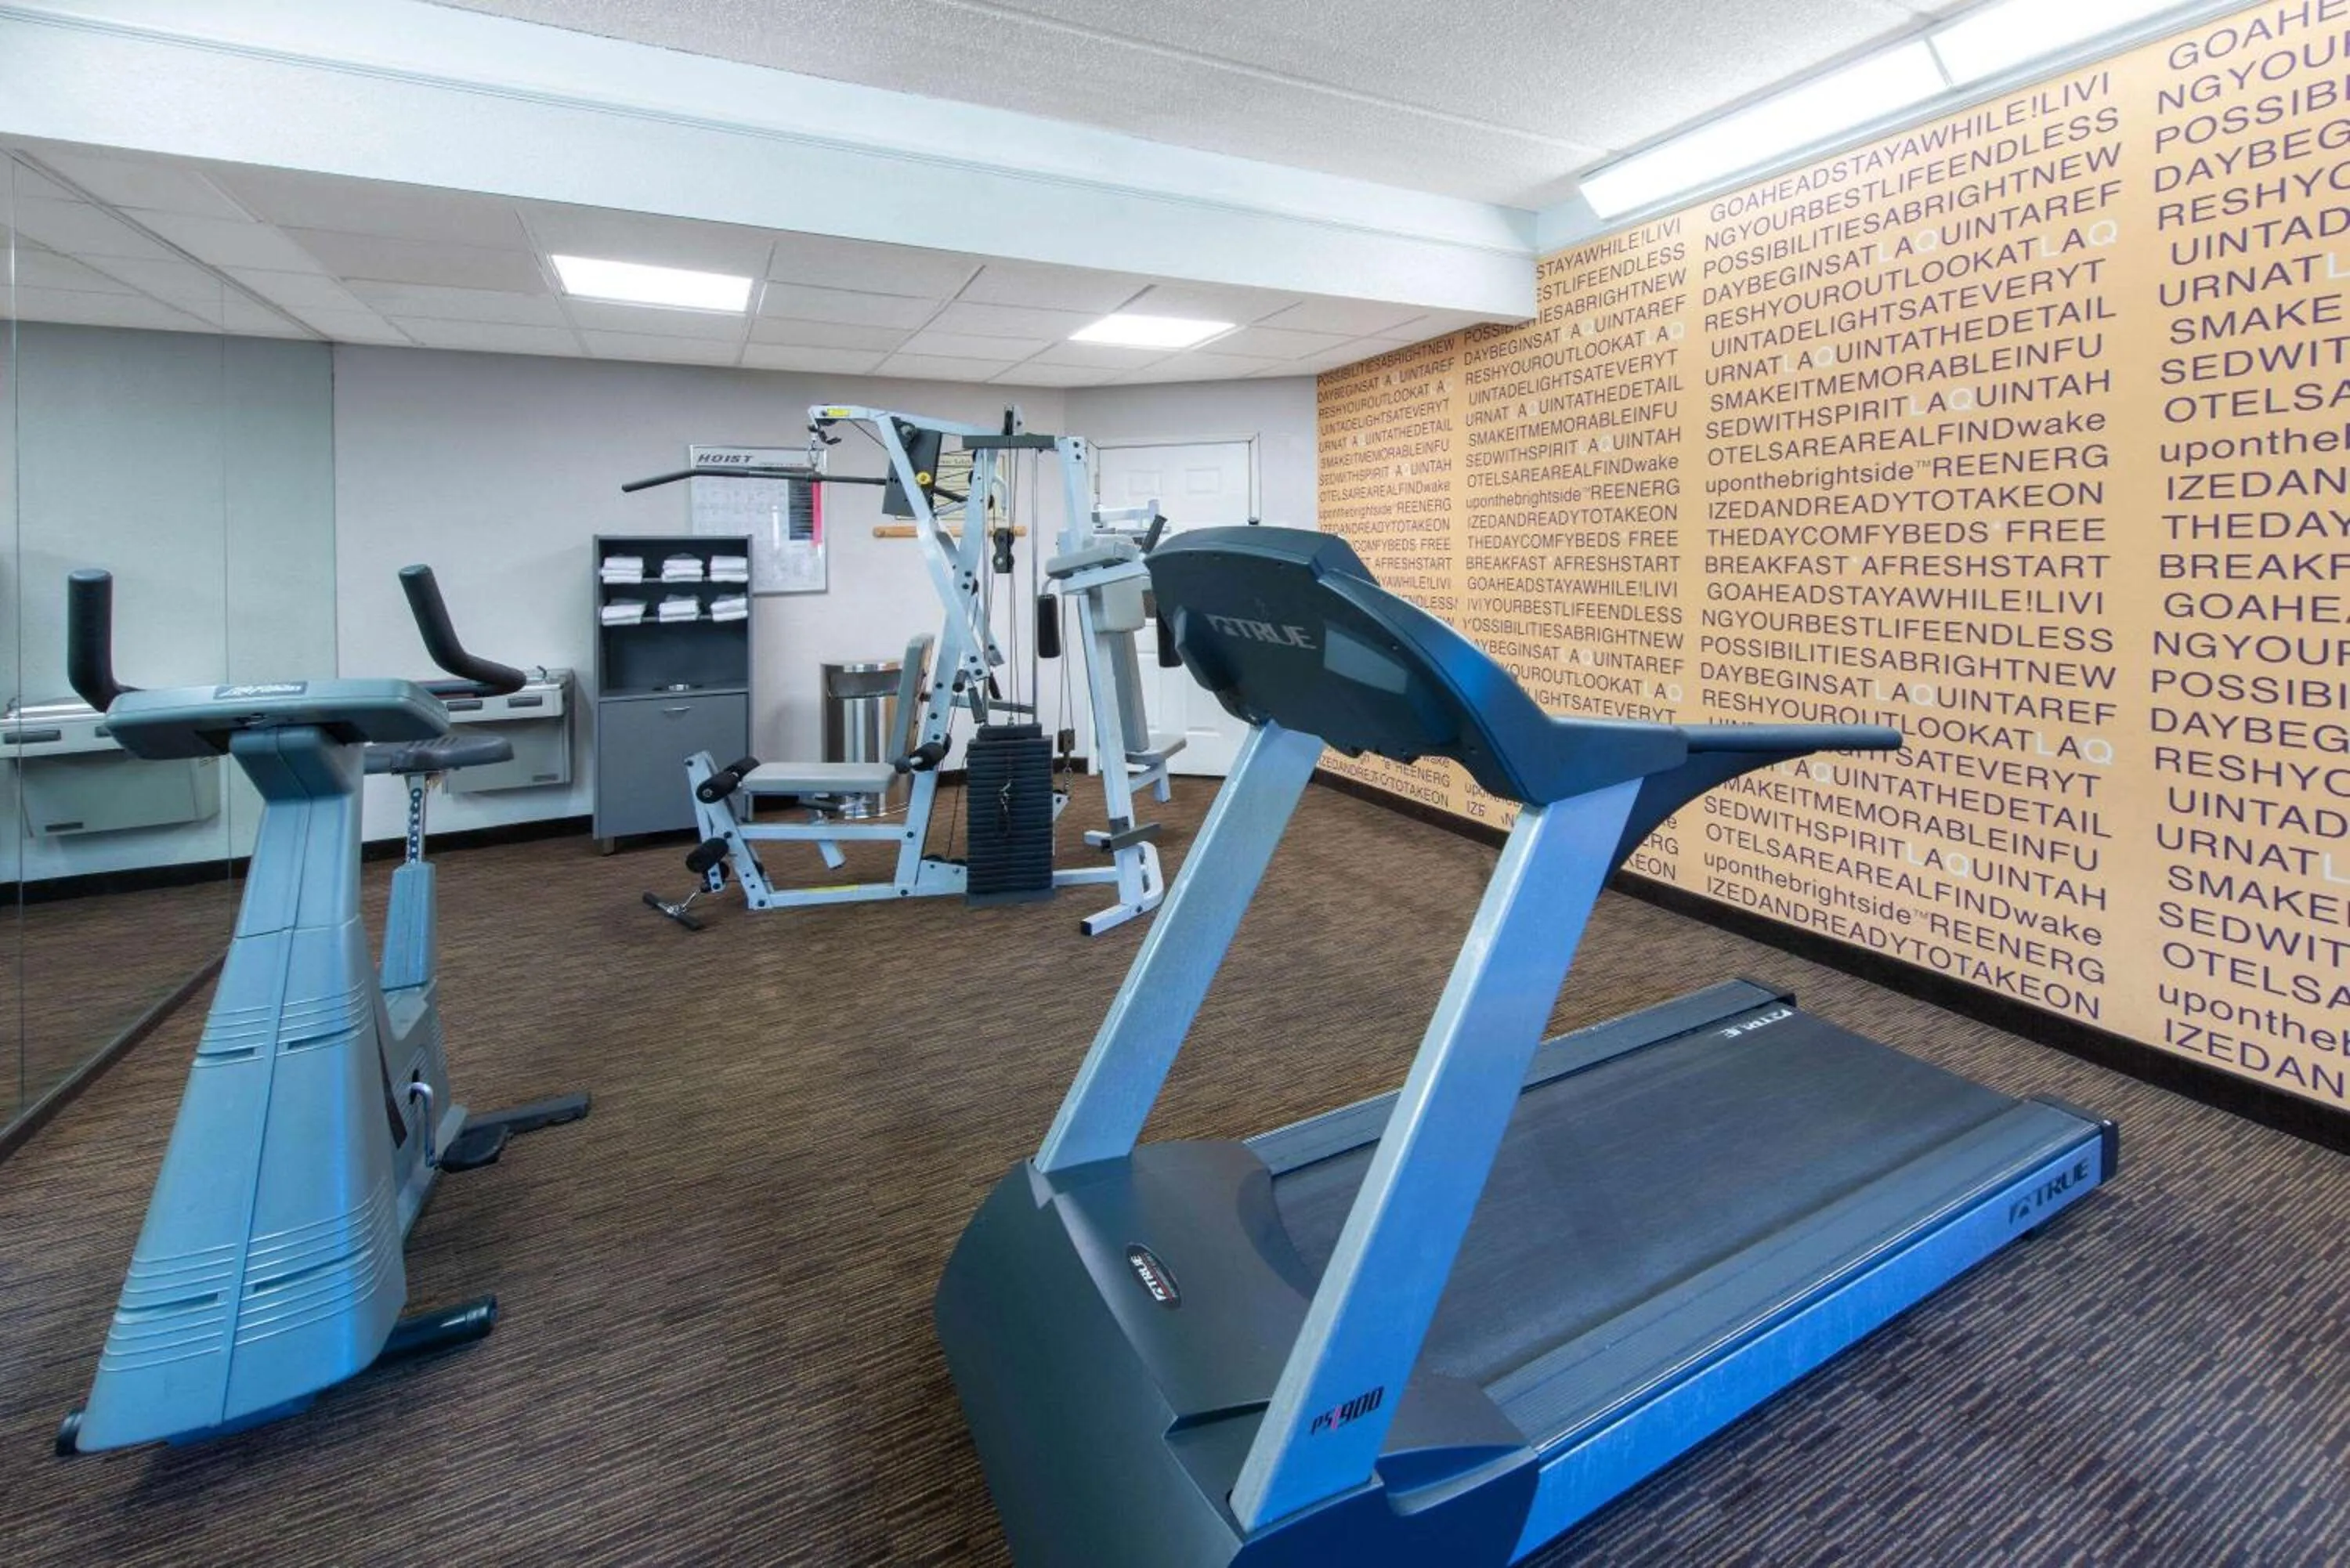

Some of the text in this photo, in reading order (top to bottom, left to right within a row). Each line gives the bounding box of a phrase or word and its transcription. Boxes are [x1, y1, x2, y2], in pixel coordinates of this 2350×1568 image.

[2169, 0, 2348, 70] GOAHE
[2159, 31, 2350, 114] NGYOU
[1711, 72, 2110, 223] GOAHEADSTAYAWHILE!LIVI
[2155, 119, 2350, 193] DAYBEG
[1705, 107, 2120, 251] NGYOURBESTLIFEENDLESS
[1704, 143, 2121, 279] POSSIBILITIESABRIGHTNEW
[2172, 207, 2350, 266] UINTAD
[1711, 258, 2106, 358] UINTADELIGHTSATEVERYT
[2171, 294, 2342, 345] SMAKE
[1710, 334, 2103, 413] SMAKEITMEMORABLEINFU
[2160, 337, 2350, 385] SEDWIT
[698, 453, 754, 463] HOIST
[1708, 410, 2106, 466] OTELSAREAREALFINDwake
[2160, 423, 2350, 467] uponthe
[1708, 482, 2103, 520] IZEDANDREADYTOTAKEON
[2167, 467, 2346, 500] IZEDAN
[1629, 530, 1679, 547] FREE
[1707, 517, 2106, 547] THEDAYCOMFYBEDS FREE
[2161, 511, 2350, 540] THEDAY
[1705, 554, 2111, 580] BREAKFAST AFRESHSTART
[1707, 583, 2102, 616] GOAHEADSTAYAWHILE!LIVI
[2164, 592, 2350, 623] GOAHE
[1227, 617, 1318, 650] TRUE
[1702, 609, 2113, 652] NGYOURBESTLIFEENDLESS
[1701, 636, 2117, 689] POSSIBILITIESABRIGHTNEW
[2152, 669, 2347, 710] POSSIBI
[2151, 707, 2350, 753] DAYBEG
[2169, 786, 2348, 838] UINTAD
[1706, 822, 2102, 946] OTELSAREAREALFINDwake
[1707, 877, 2099, 1019] IZEDANDREADYTOTAKEON
[2159, 901, 2350, 967] SEDWIT
[2165, 1018, 2344, 1098] IZEDAN
[2036, 1157, 2090, 1205] TRUE
